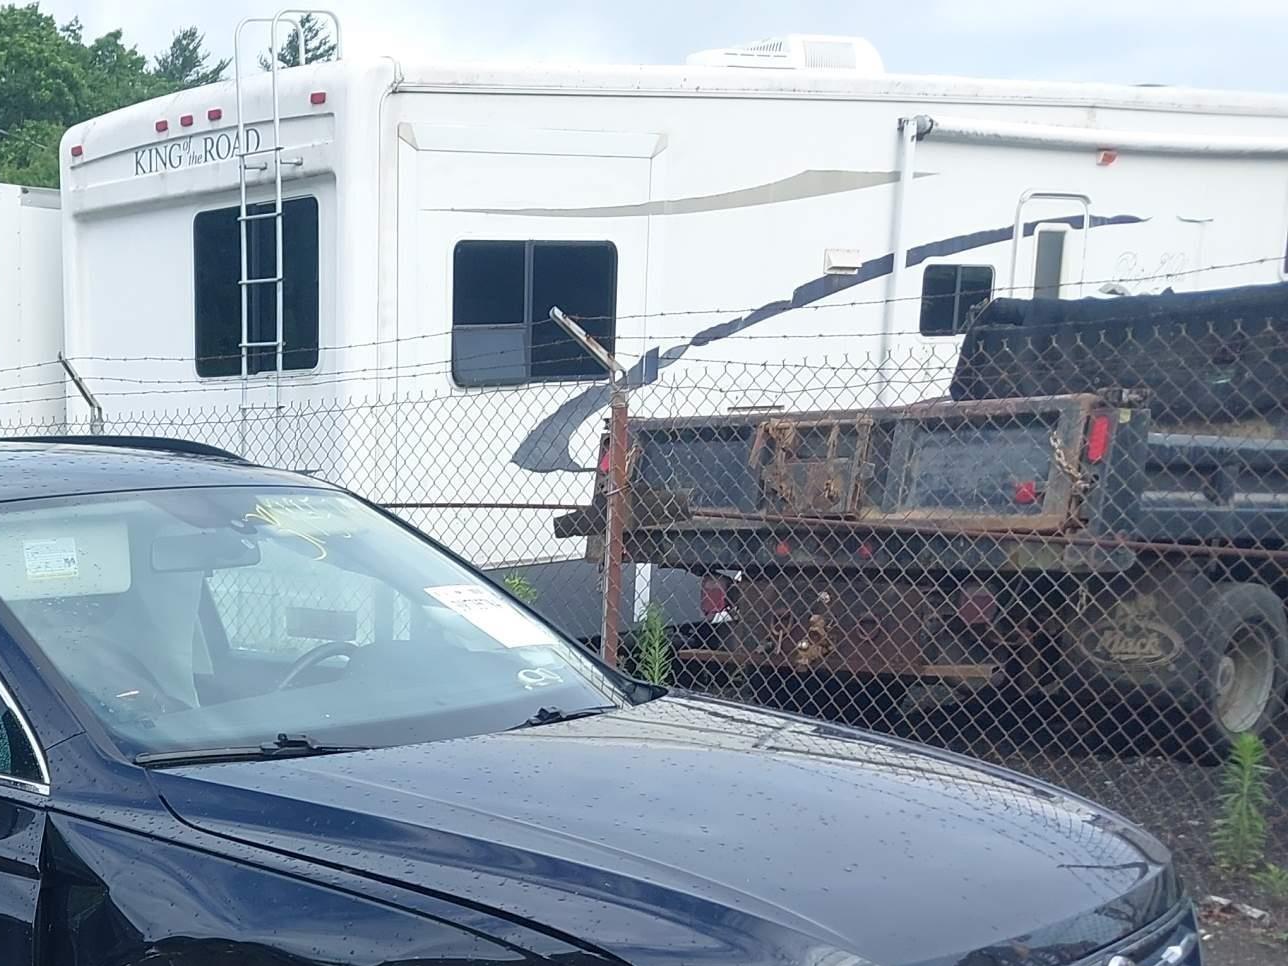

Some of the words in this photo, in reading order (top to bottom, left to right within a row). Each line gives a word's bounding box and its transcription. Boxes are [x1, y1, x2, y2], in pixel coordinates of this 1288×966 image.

[134, 142, 182, 176] KING
[182, 135, 193, 154] of
[188, 151, 203, 166] the
[203, 128, 260, 163] ROAD
